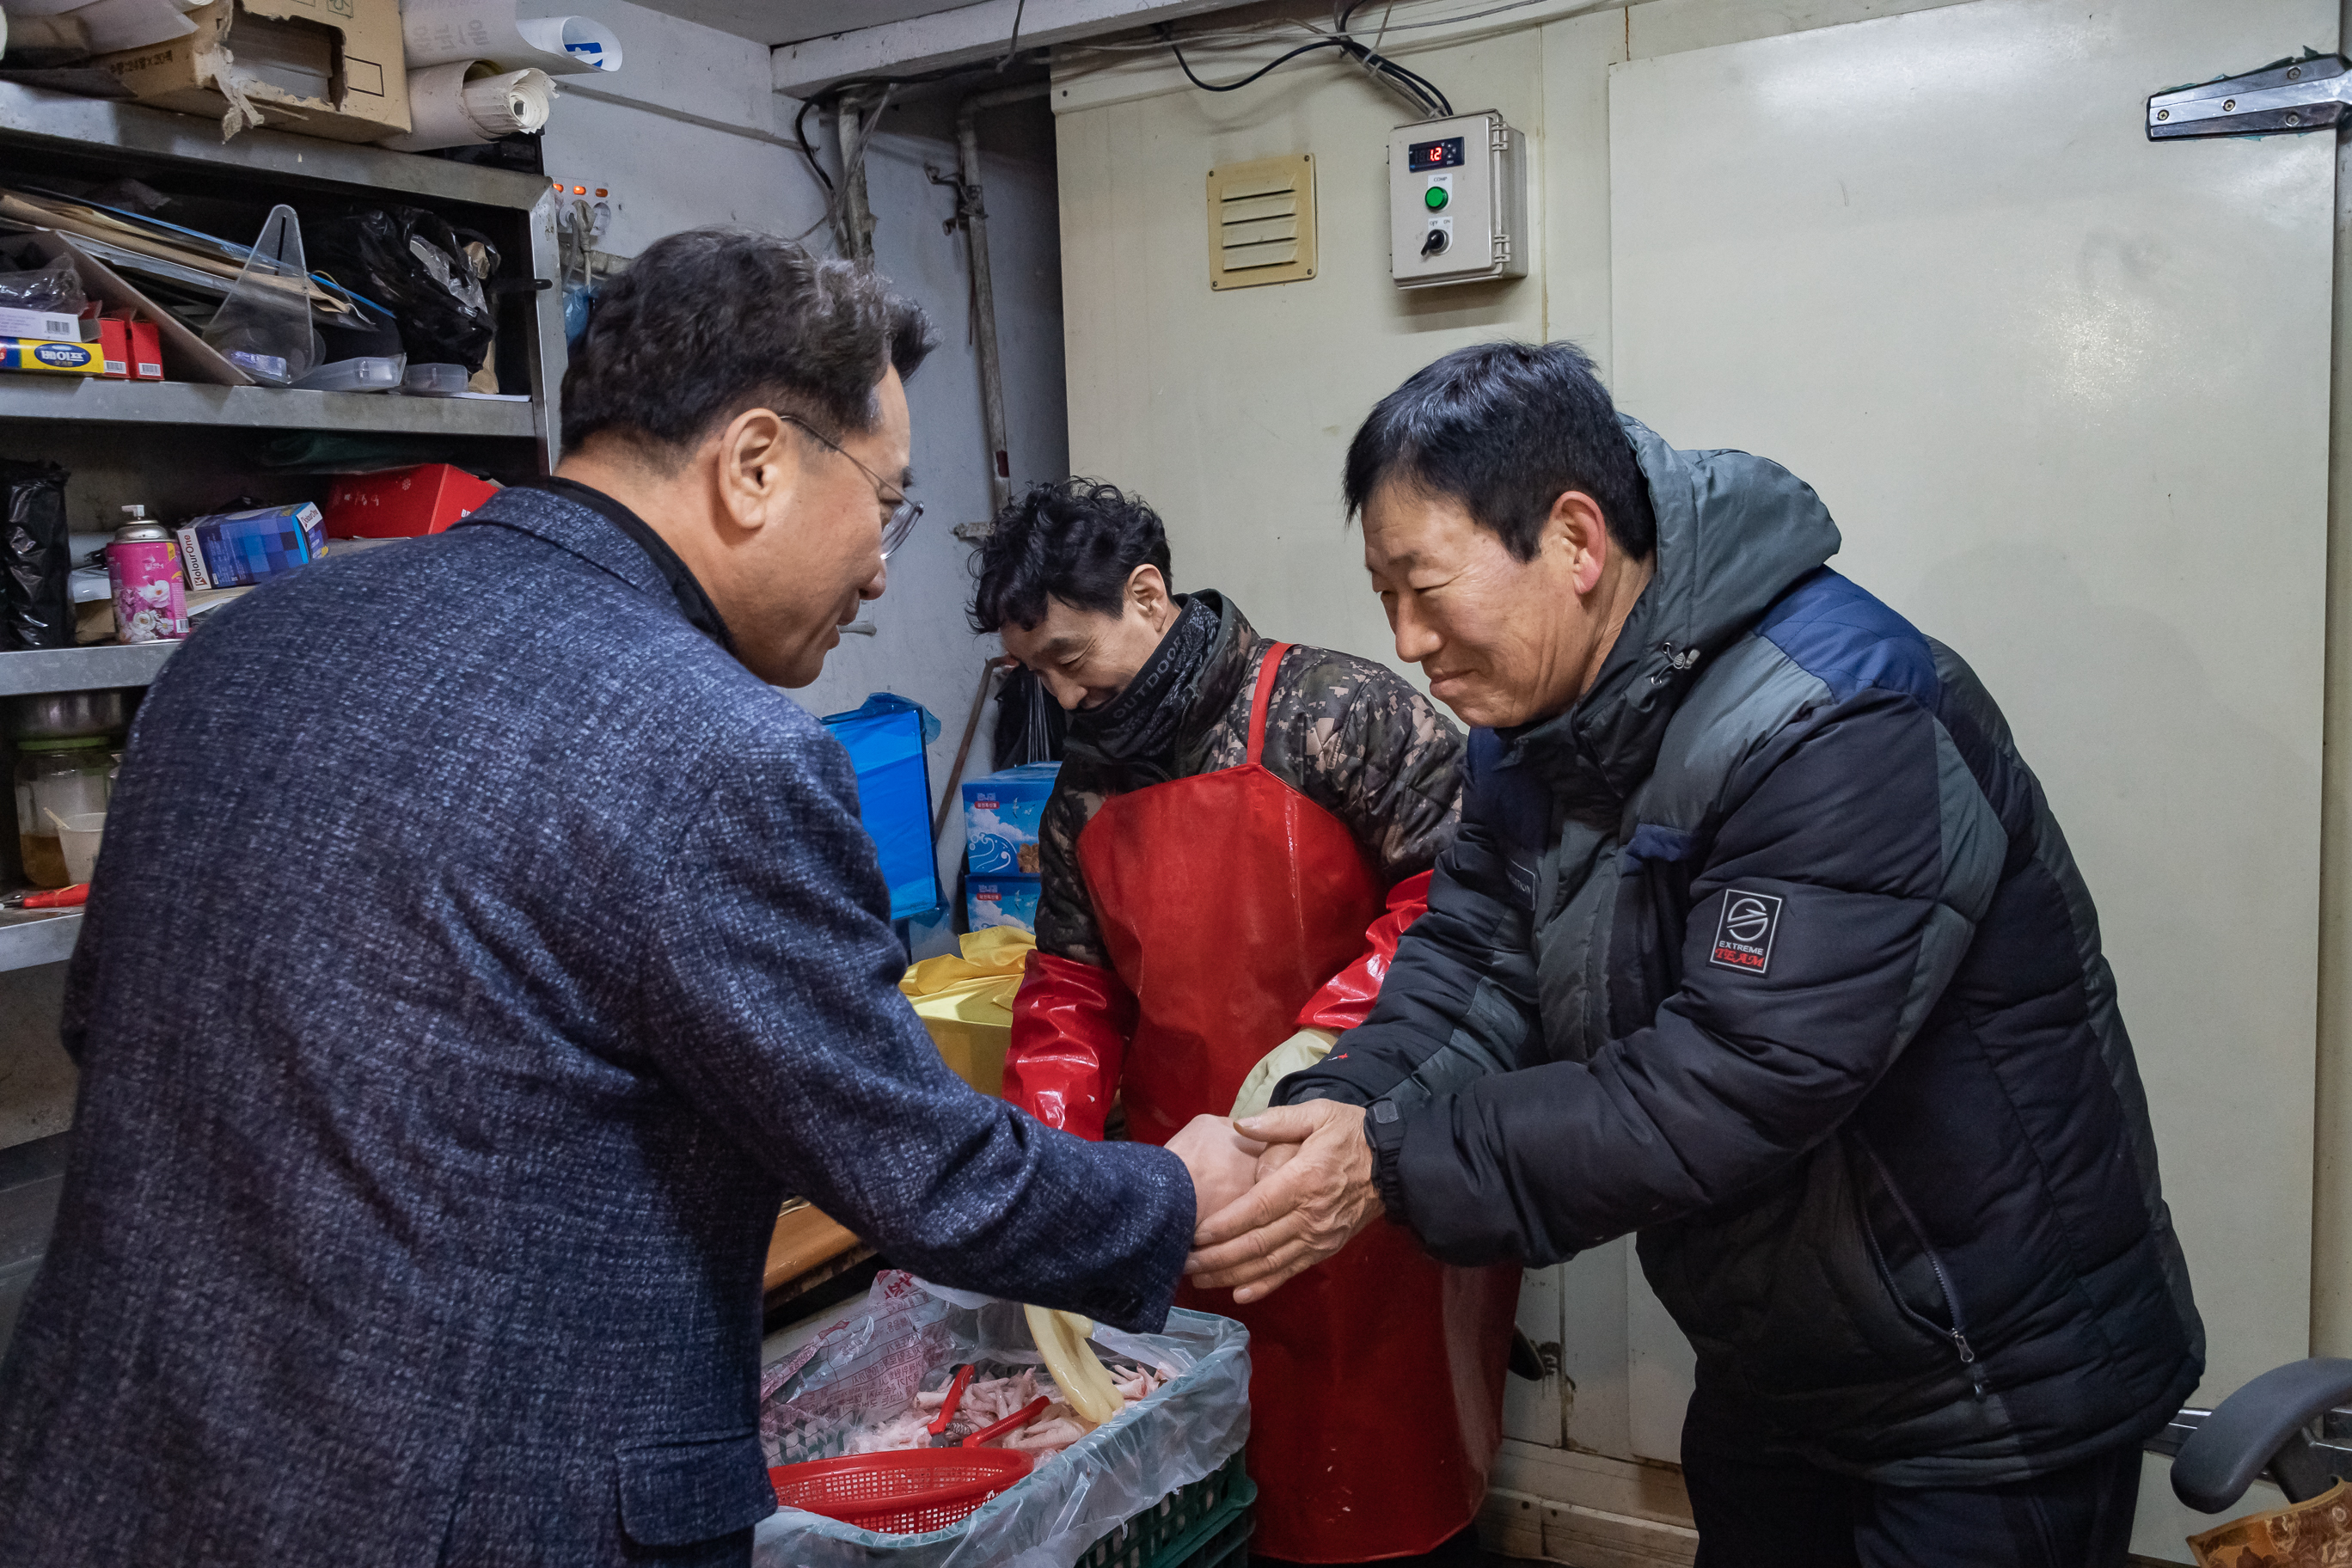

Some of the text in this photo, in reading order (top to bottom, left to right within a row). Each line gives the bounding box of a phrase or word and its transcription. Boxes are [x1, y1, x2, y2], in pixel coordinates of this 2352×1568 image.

[40, 350, 83, 362] 베이프
[183, 535, 208, 586] KolourOne
[1719, 940, 1764, 956] EXTREME
[1715, 948, 1765, 967] TEAM
